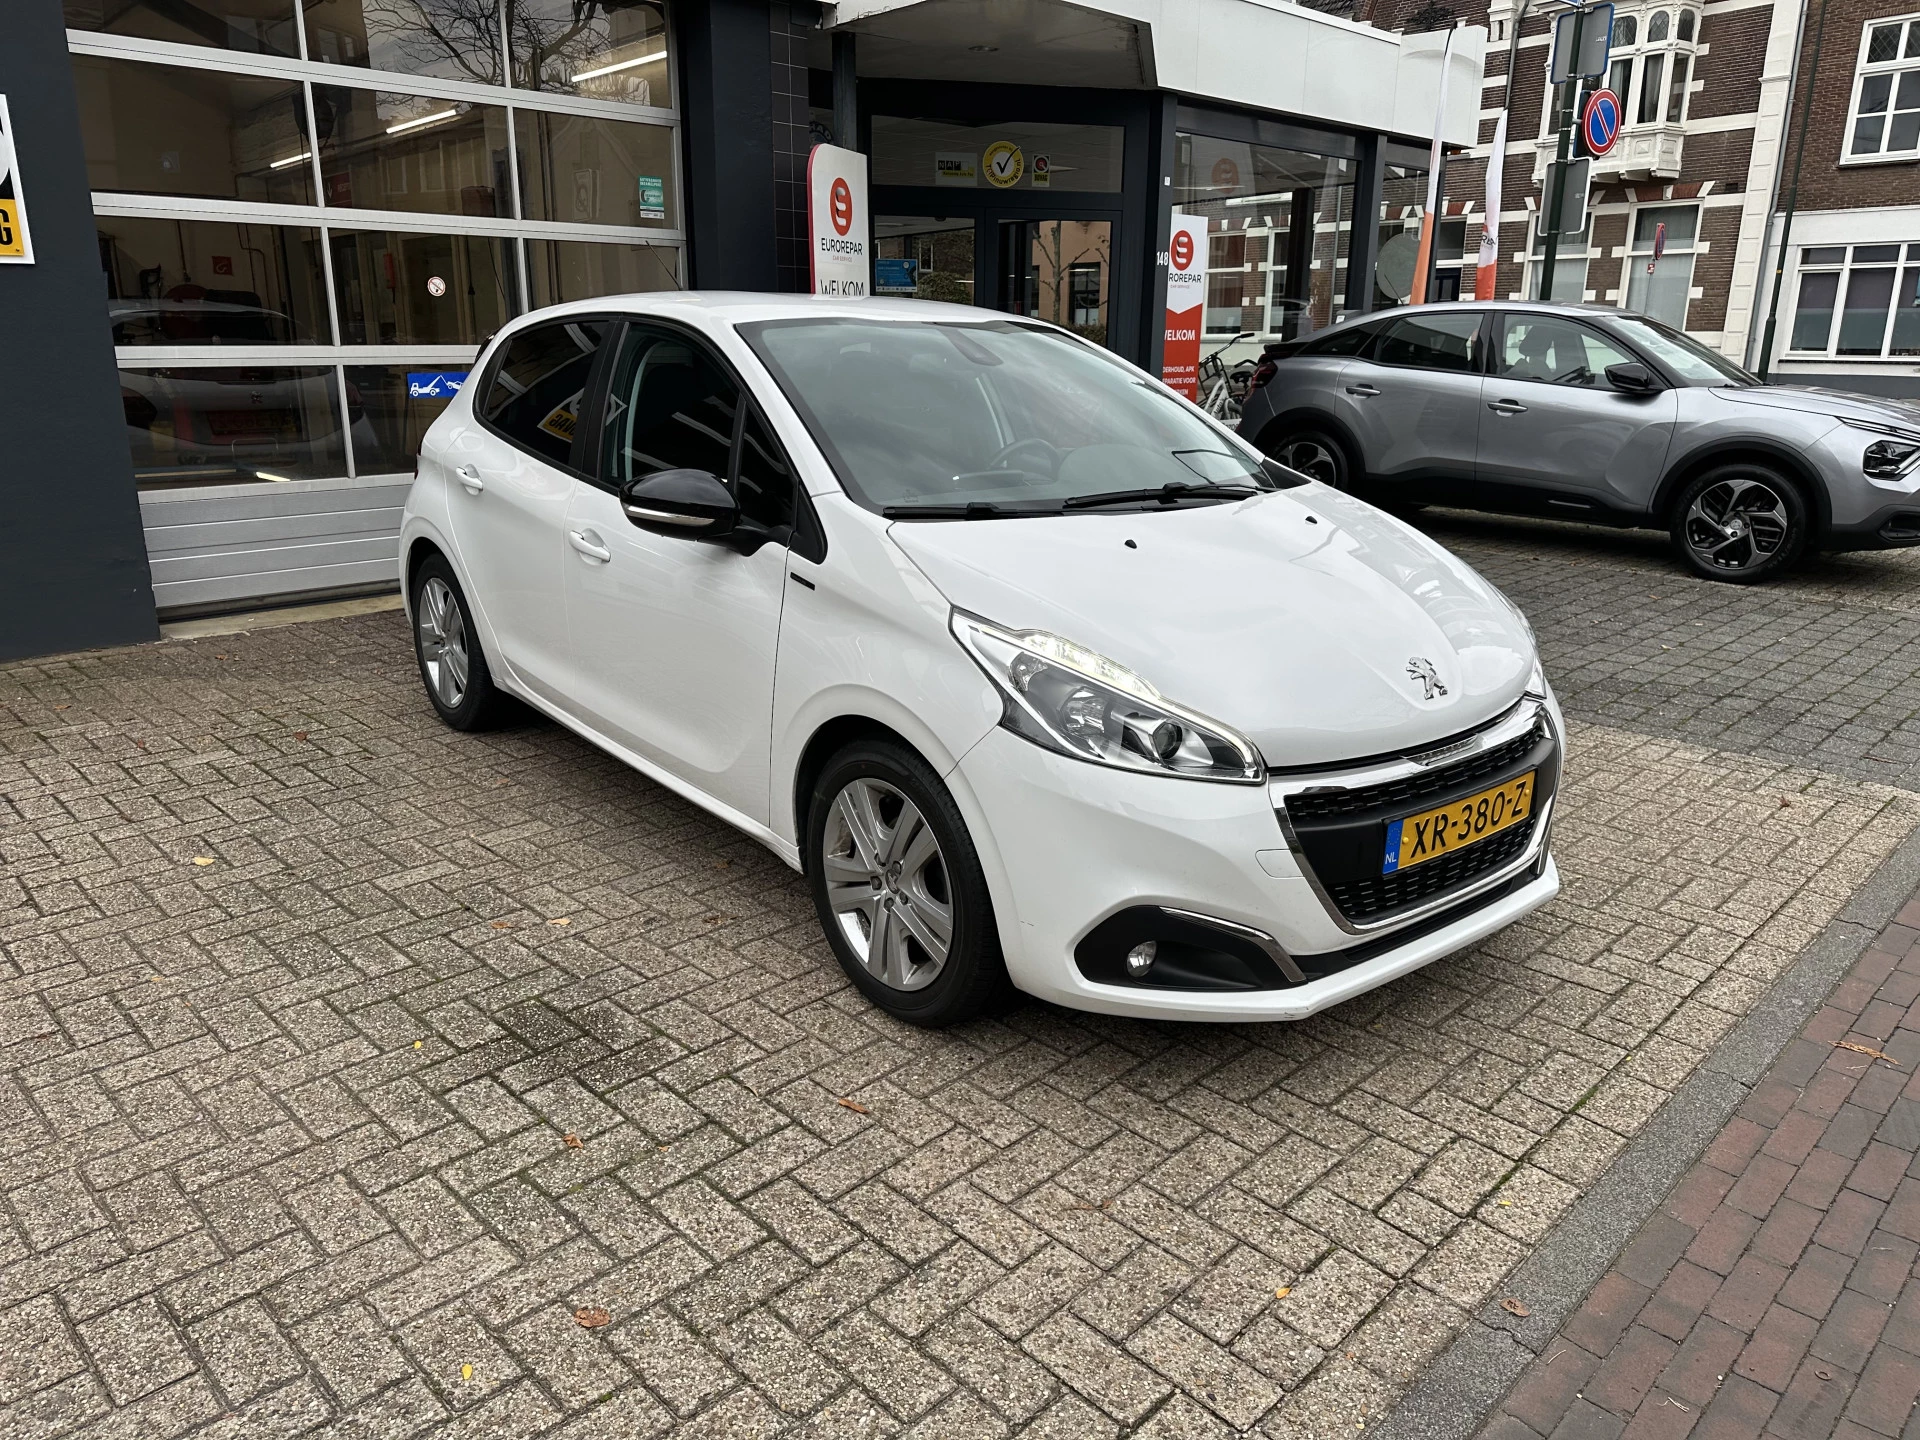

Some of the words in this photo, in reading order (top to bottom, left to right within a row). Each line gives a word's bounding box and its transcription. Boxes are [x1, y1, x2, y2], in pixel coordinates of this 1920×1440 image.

[938, 160, 961, 170] NAP
[821, 238, 863, 256] EUROREPAR
[1156, 251, 1169, 266] 148
[1410, 780, 1527, 859] XR-380-Z
[1385, 852, 1397, 864] NL
